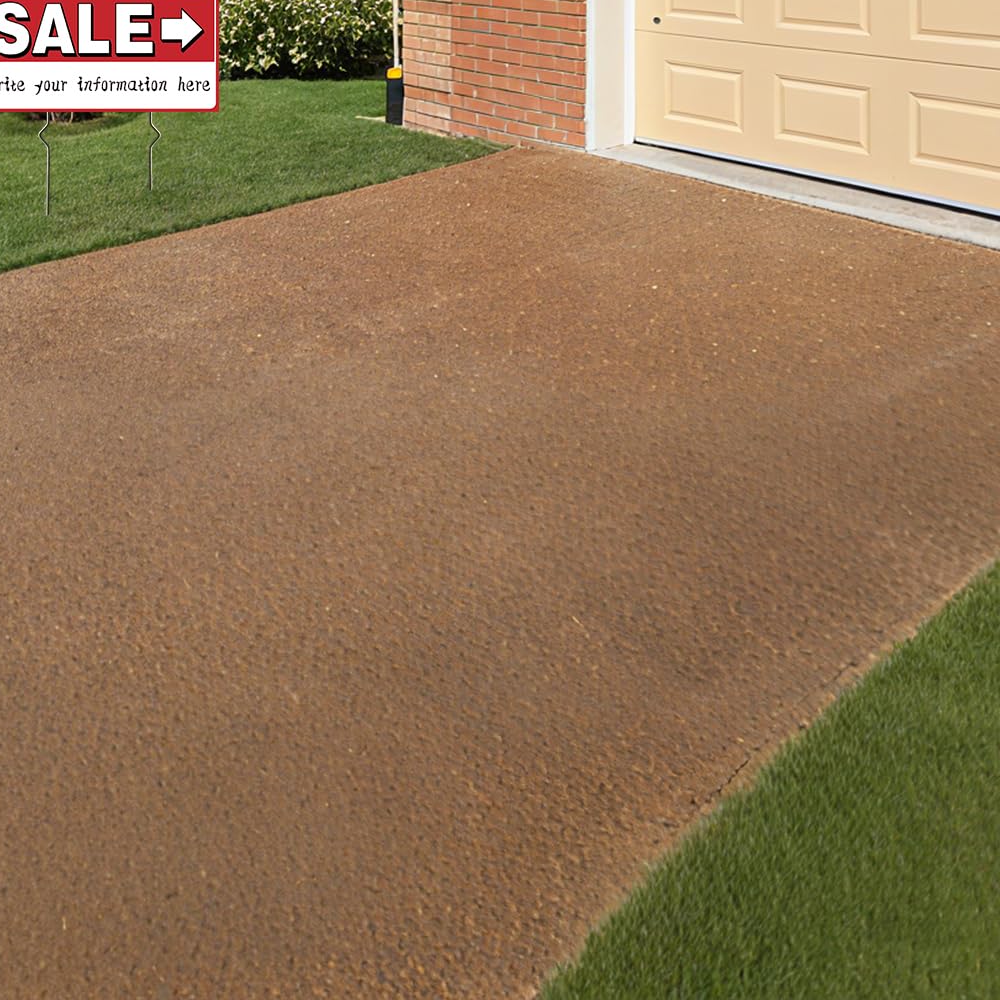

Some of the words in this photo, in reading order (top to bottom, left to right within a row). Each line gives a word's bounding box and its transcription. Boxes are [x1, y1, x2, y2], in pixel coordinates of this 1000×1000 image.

[34, 80, 68, 95] your
[77, 76, 167, 92] information
[177, 76, 211, 92] here
